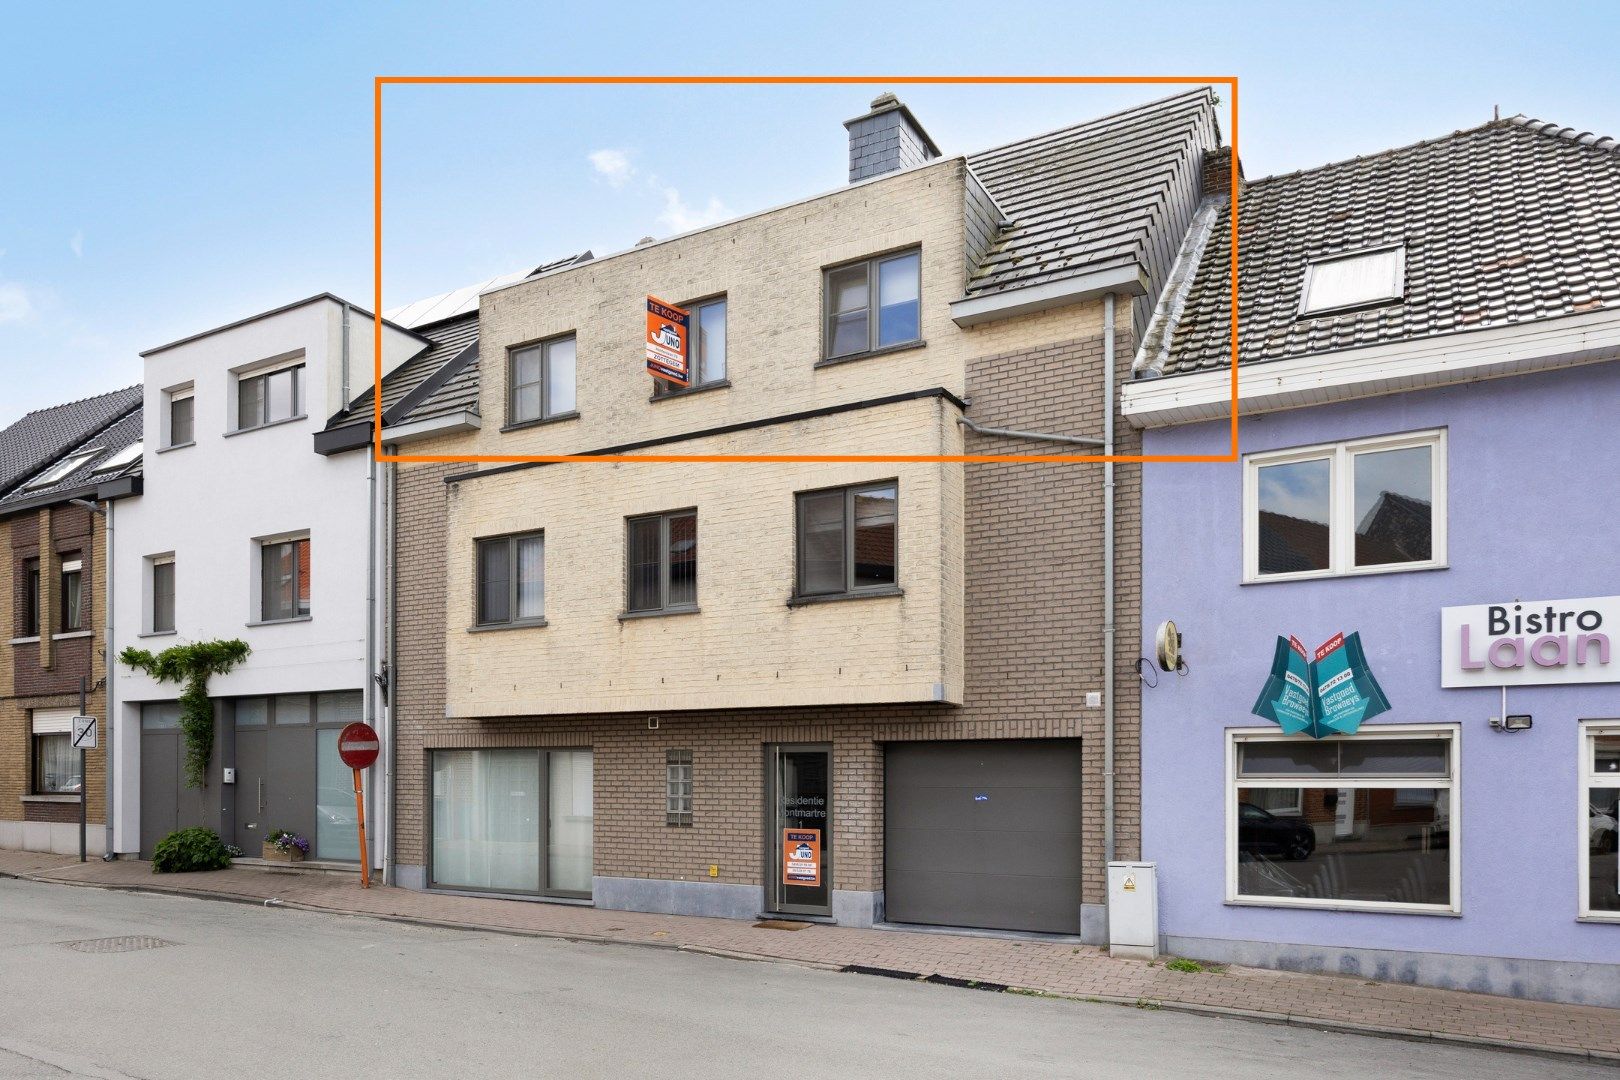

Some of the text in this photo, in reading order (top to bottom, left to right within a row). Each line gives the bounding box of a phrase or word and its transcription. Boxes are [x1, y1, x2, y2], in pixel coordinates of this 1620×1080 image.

[649, 302, 684, 323] TE KOOP
[1489, 604, 1603, 636] Bistro
[1316, 637, 1342, 659] TE KOOP
[1459, 623, 1611, 671] Laan
[1322, 681, 1356, 705] Vastgoed
[1324, 694, 1361, 716] Browaeys
[77, 727, 93, 738] 30
[781, 808, 826, 818] ontmartre
